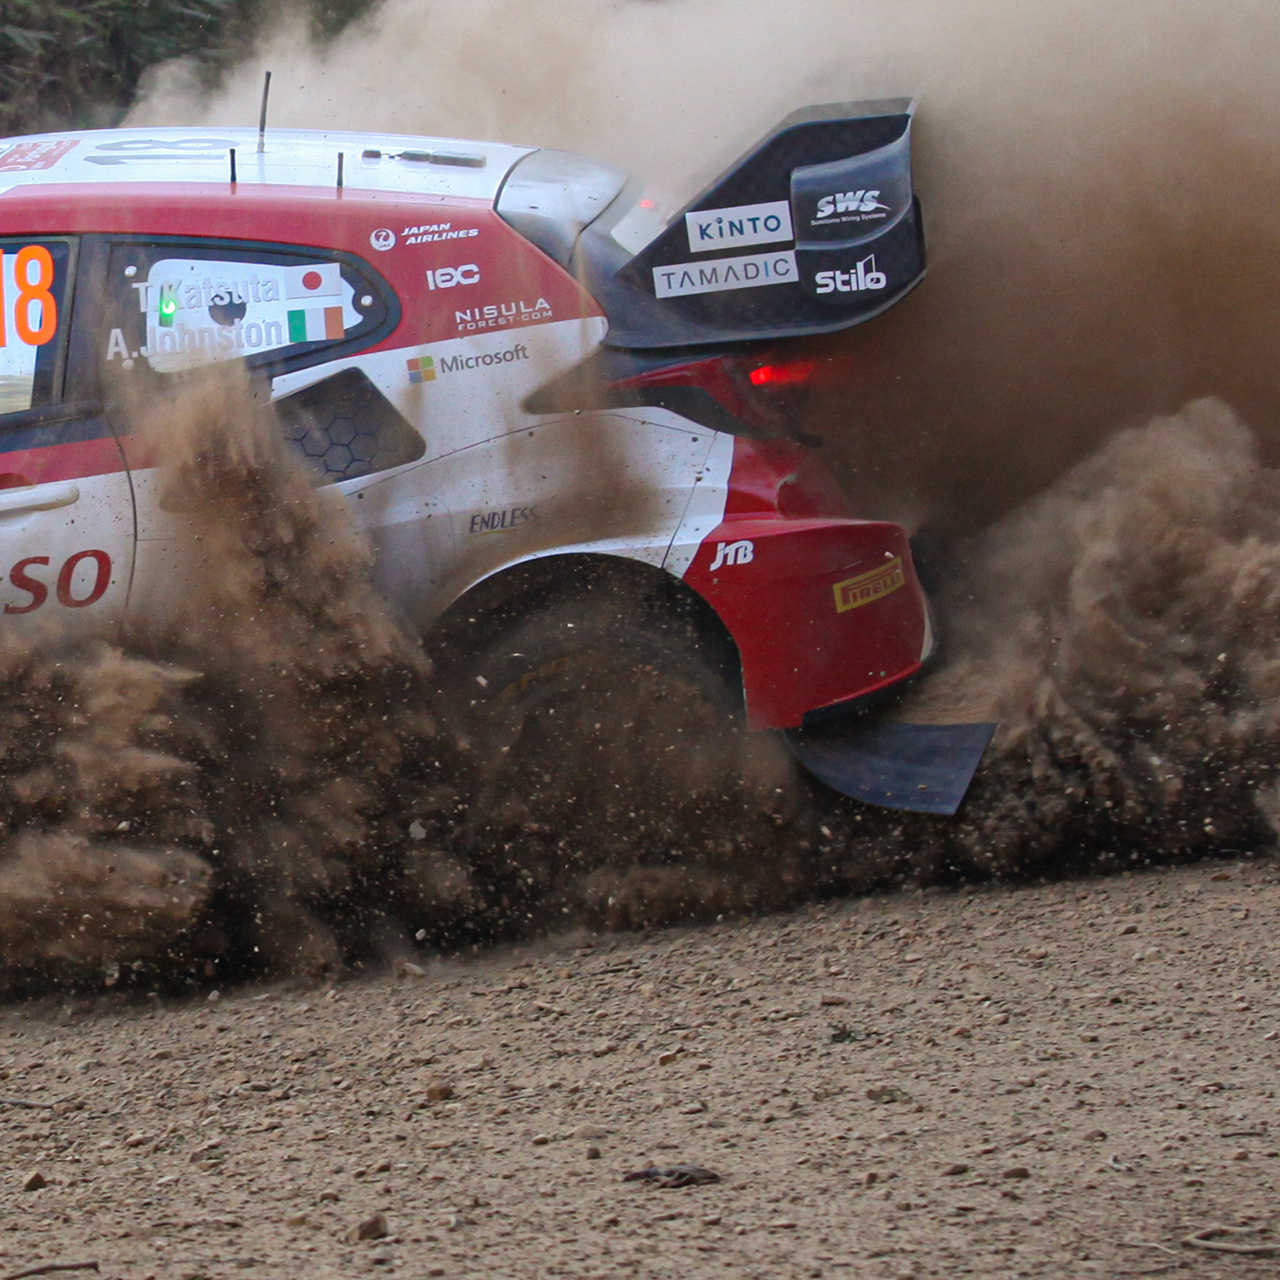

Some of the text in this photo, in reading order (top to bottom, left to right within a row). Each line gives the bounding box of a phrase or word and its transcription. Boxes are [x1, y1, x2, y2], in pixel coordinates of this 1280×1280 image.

[816, 189, 884, 219] SWS
[401, 223, 451, 237] JAPAN
[405, 229, 479, 246] AIRLINES
[661, 258, 791, 290] TAMADIC
[815, 254, 887, 295] Stilo
[455, 297, 551, 324] NISULA
[440, 344, 530, 374] Microsoft
[470, 505, 540, 534] ENDLESS
[709, 540, 754, 571] JTB
